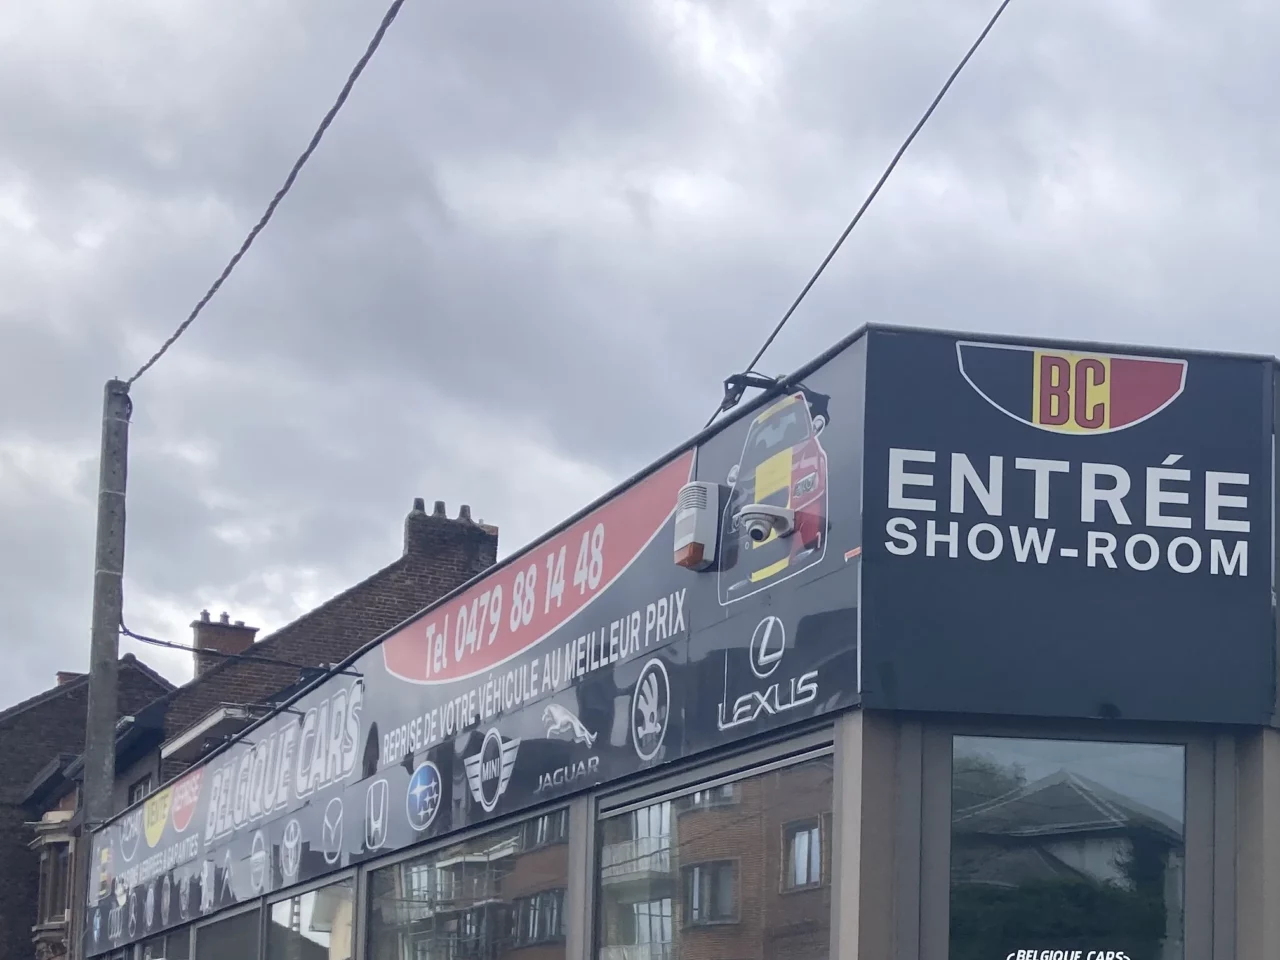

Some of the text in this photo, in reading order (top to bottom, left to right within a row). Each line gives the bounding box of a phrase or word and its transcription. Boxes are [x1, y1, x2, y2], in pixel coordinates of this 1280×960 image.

[1039, 355, 1105, 429] BC
[887, 447, 1251, 533] ENTRÉE
[884, 516, 1248, 577] SHOW-ROOM
[425, 522, 605, 679] Tel 0479 88 14 48
[383, 587, 687, 765] REPRISE DE VOTRE VÉHICULE AU MEILLEUR PRIX
[718, 670, 818, 731] LEXUS
[204, 676, 364, 847] BELGIQUE CARS
[482, 757, 500, 782] MINI
[533, 756, 600, 794] JAGUAR
